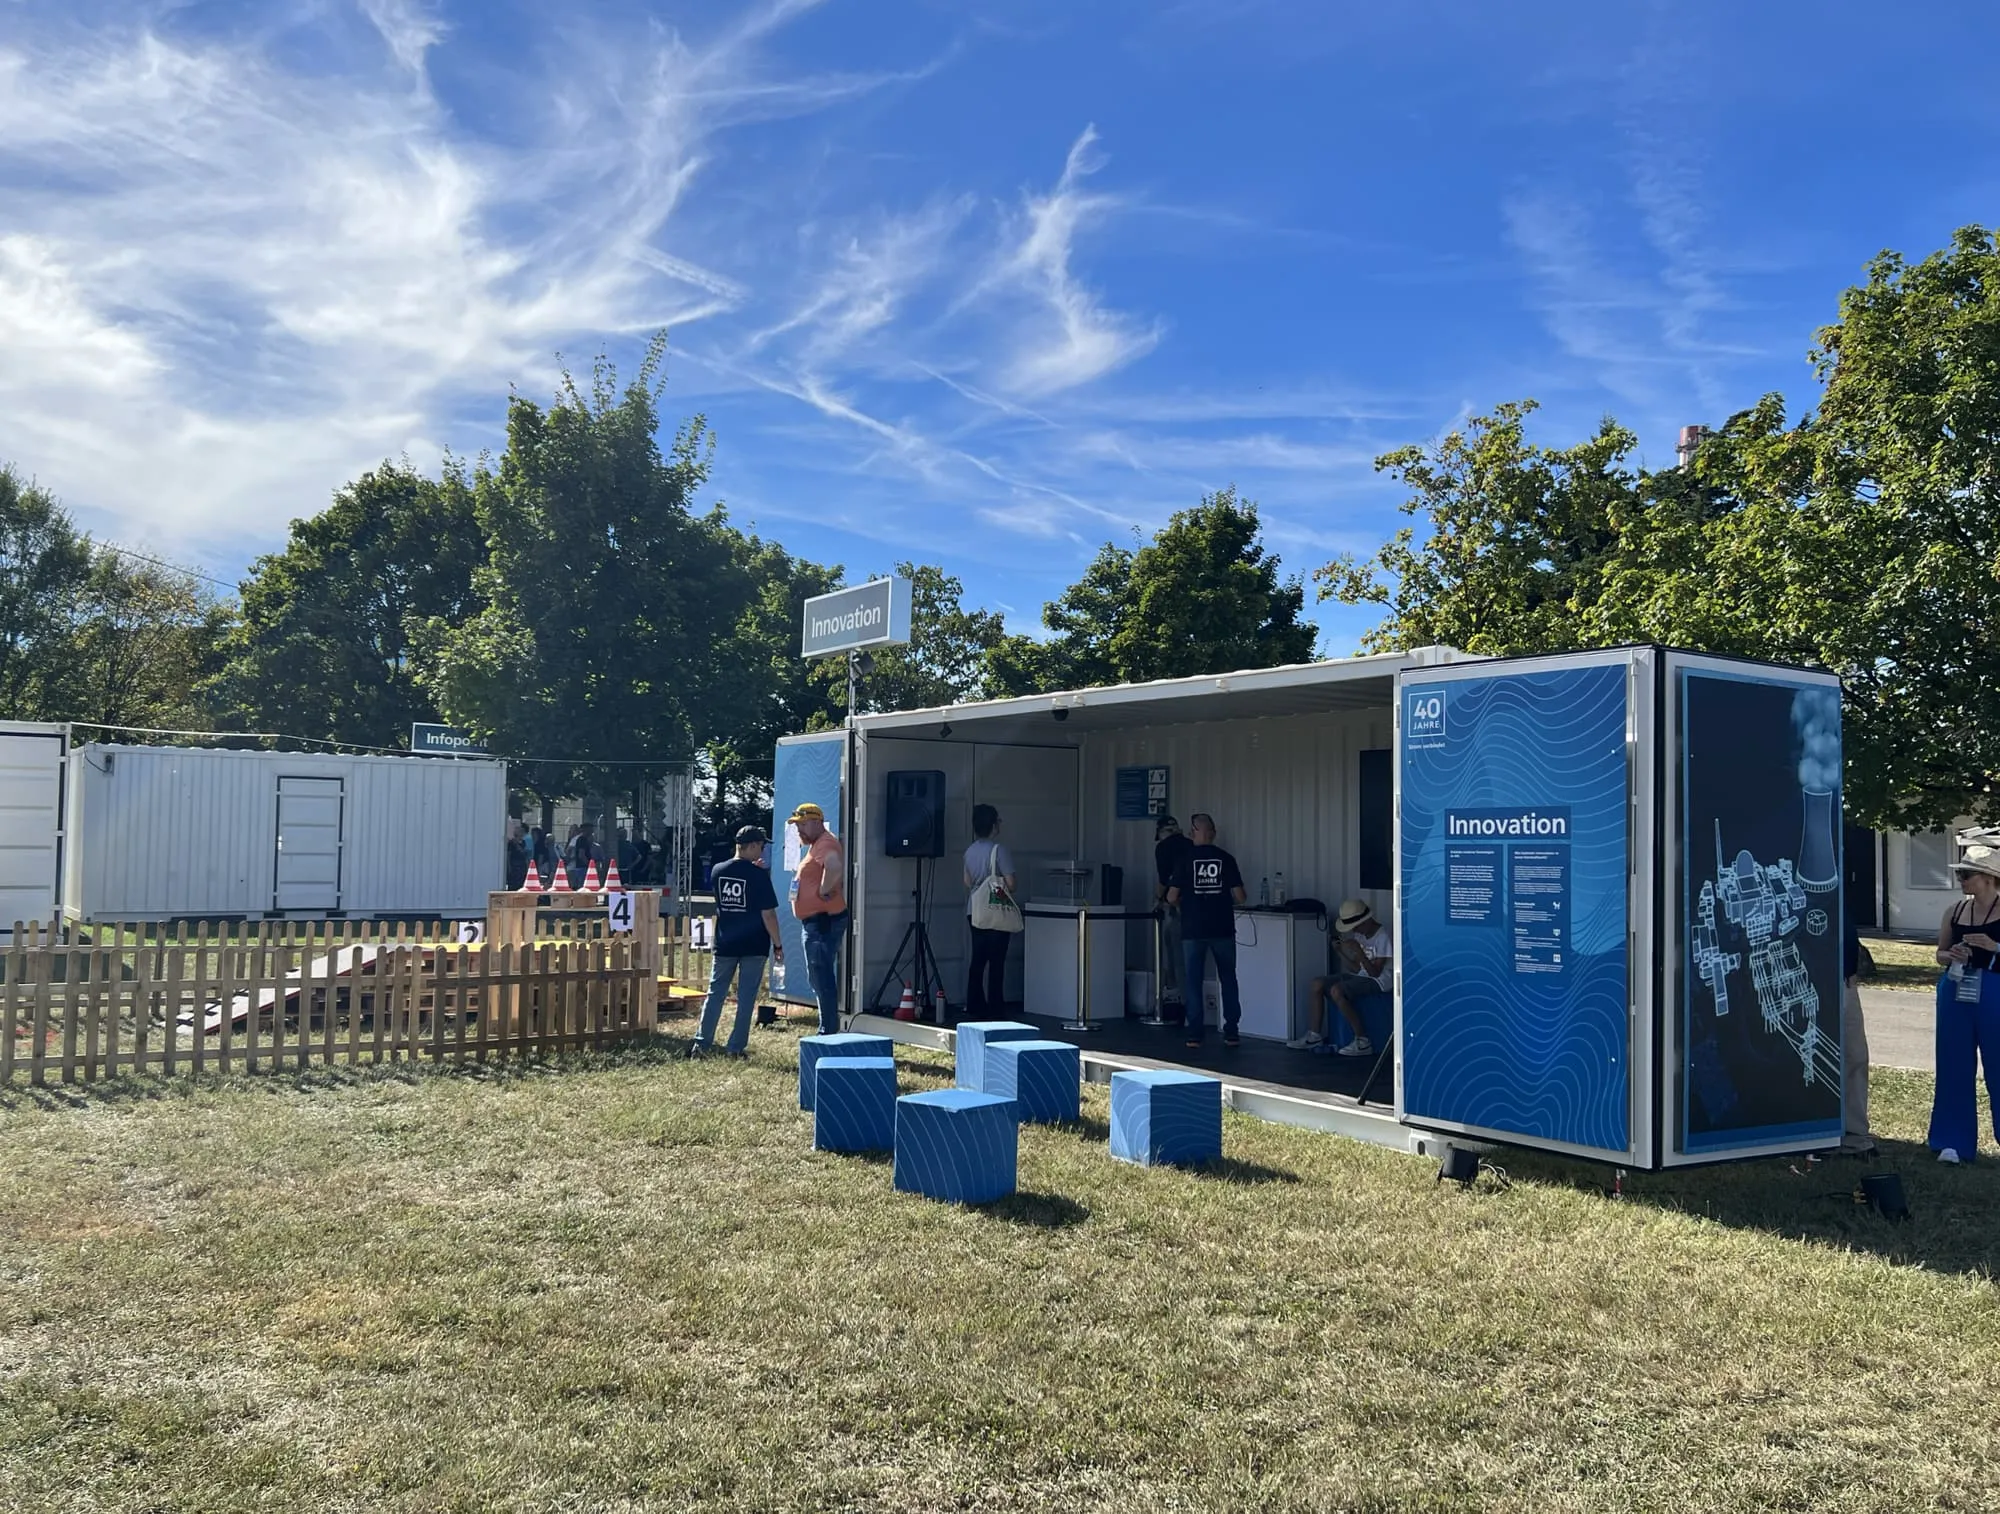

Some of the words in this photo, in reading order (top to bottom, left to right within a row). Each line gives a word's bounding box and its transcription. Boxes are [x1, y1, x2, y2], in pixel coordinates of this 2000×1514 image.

[812, 604, 881, 638] Innovation
[1413, 698, 1441, 719] 40
[1413, 720, 1440, 730] JAHRE
[1449, 812, 1566, 835] Innovation
[1197, 863, 1218, 878] 40
[722, 881, 742, 897] 40
[612, 898, 631, 926] 4
[694, 922, 709, 947] 1
